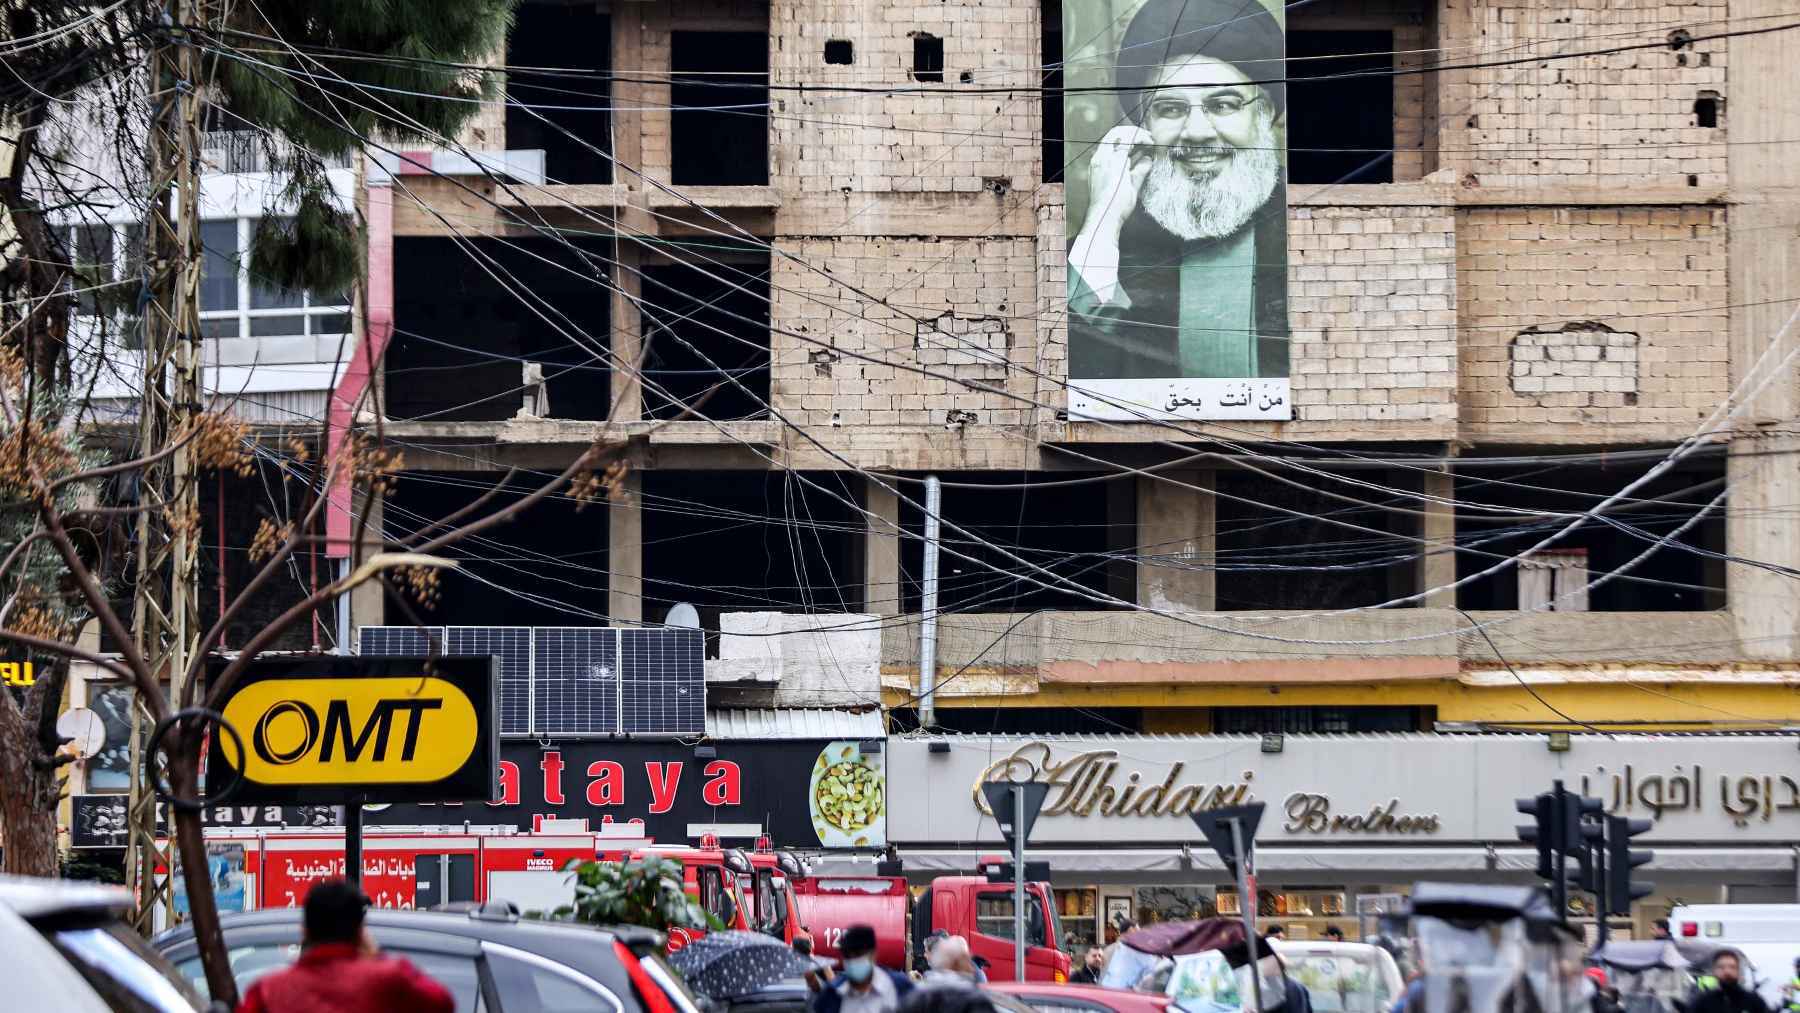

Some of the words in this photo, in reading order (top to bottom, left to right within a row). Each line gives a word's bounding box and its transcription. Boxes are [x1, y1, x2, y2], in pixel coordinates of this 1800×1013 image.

[253, 700, 443, 765] OMT
[487, 751, 741, 814] ataya
[1284, 792, 1440, 834] Brothers
[526, 858, 553, 866] IVECO
